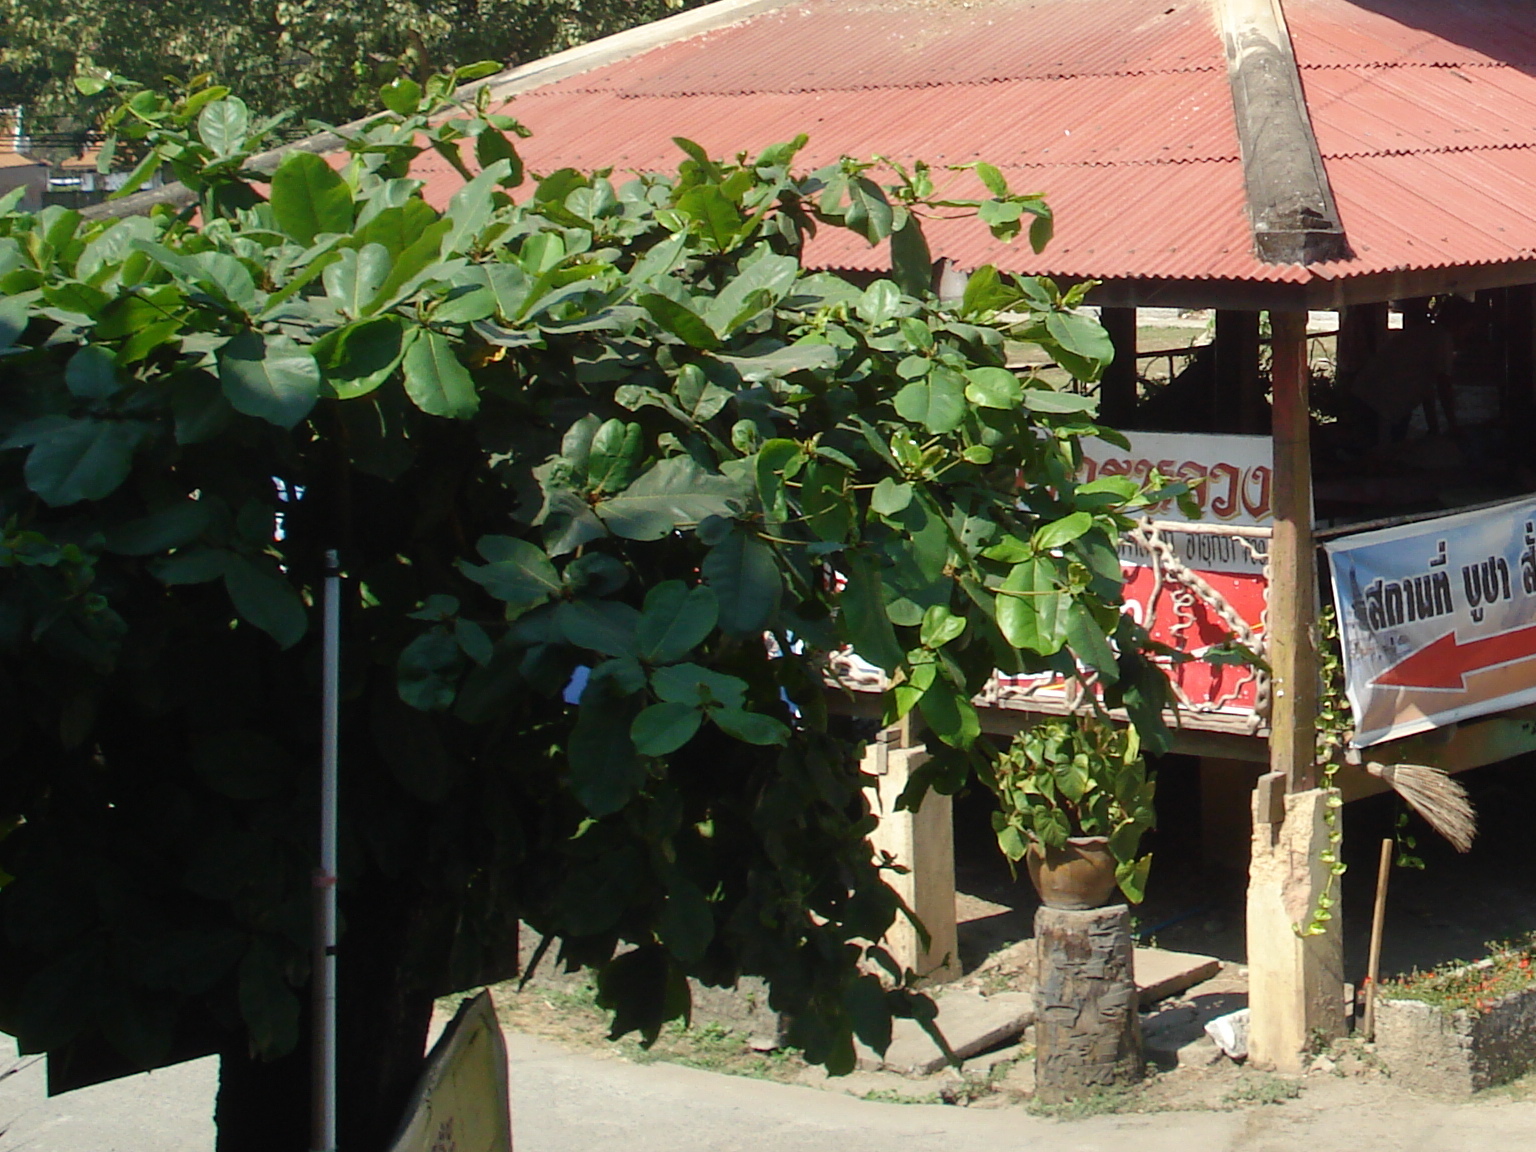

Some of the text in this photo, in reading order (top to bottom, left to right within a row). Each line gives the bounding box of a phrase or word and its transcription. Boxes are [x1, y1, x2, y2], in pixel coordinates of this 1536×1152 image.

[1364, 540, 1454, 632] สถานที่
[1461, 555, 1512, 624] บูชา
